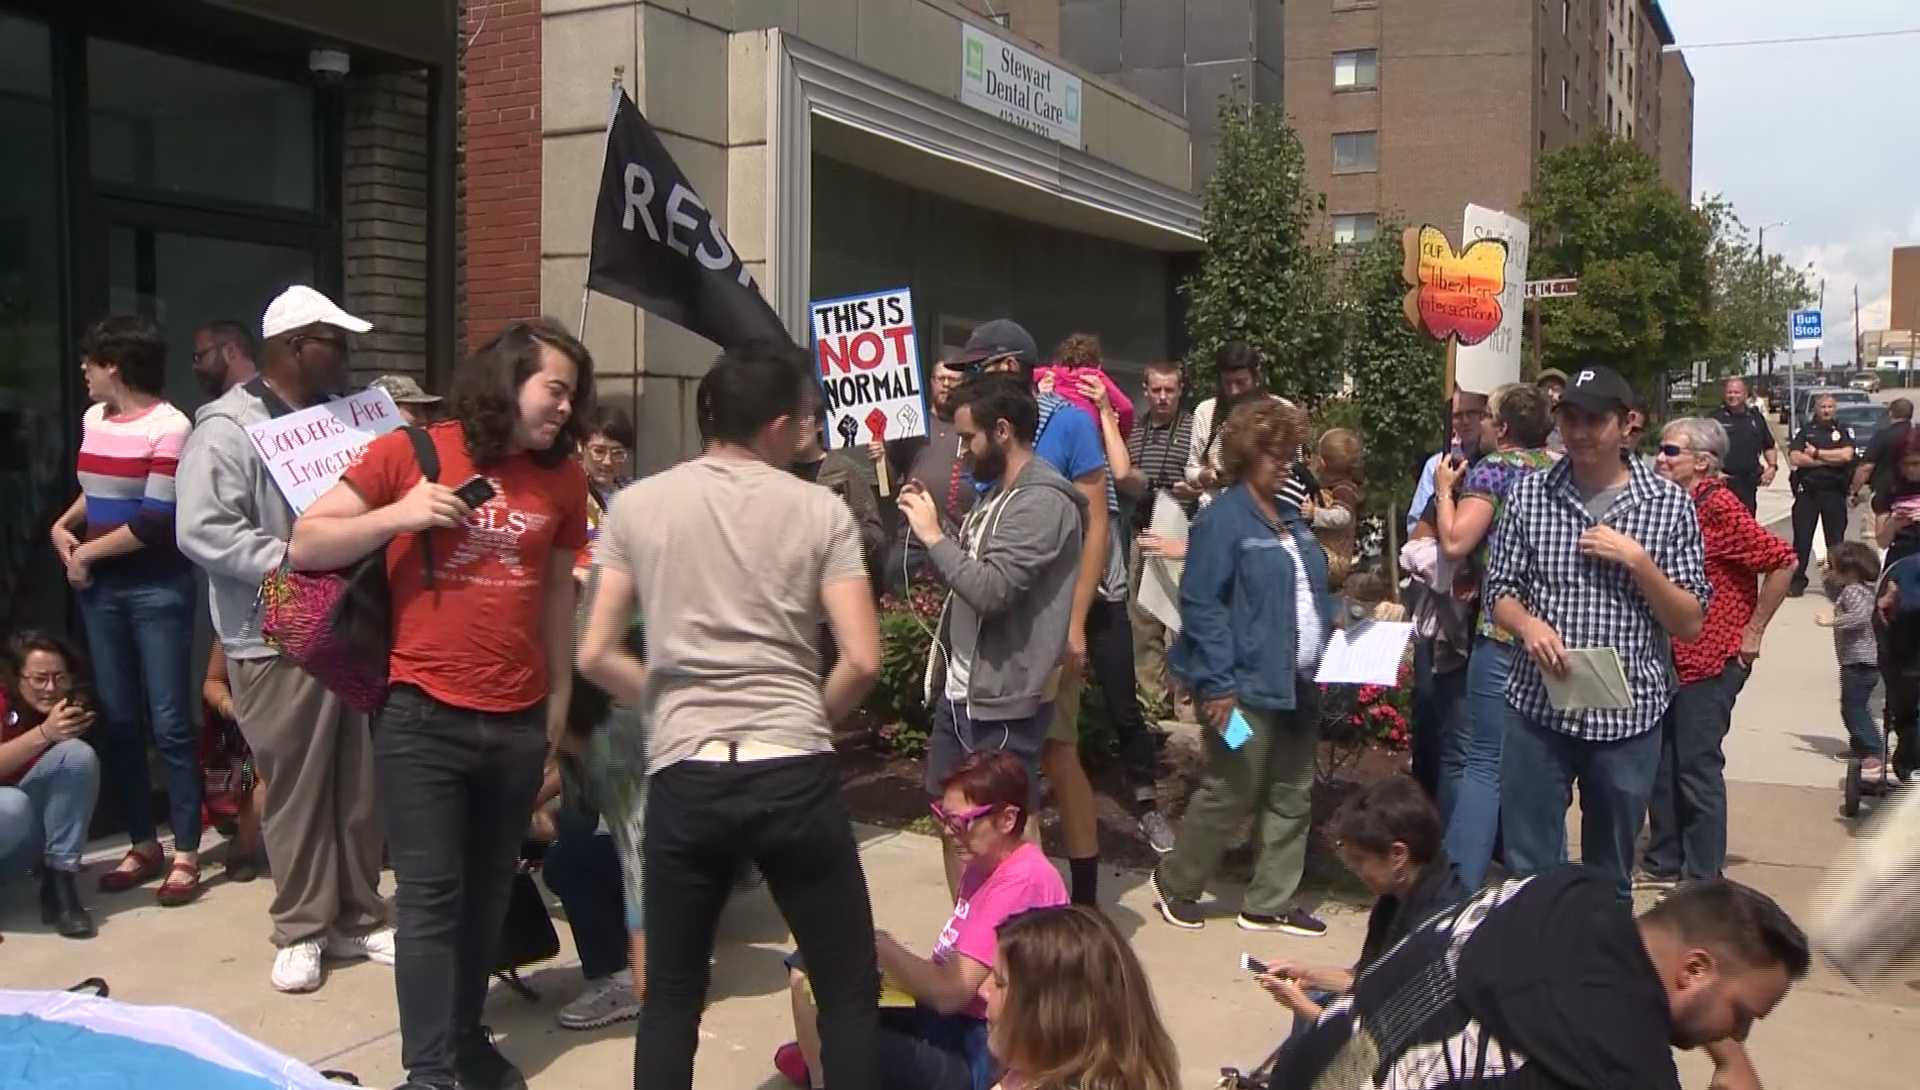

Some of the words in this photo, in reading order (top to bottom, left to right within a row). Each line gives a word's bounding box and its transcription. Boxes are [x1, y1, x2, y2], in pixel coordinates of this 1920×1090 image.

[1001, 47, 1051, 93] Stewart
[986, 69, 1031, 112] Dental
[1033, 91, 1063, 125] Care
[1524, 282, 1557, 297] ENCE
[815, 301, 875, 335] THIS
[878, 297, 904, 326] IS
[1795, 326, 1821, 336] Stop
[1796, 315, 1818, 324] Bus
[818, 326, 913, 376] NOT
[823, 367, 919, 417] NORMAL
[1576, 371, 1596, 387] P
[252, 415, 345, 461] BORDERS
[350, 400, 389, 427] ARE
[281, 445, 364, 488] IMAGIN
